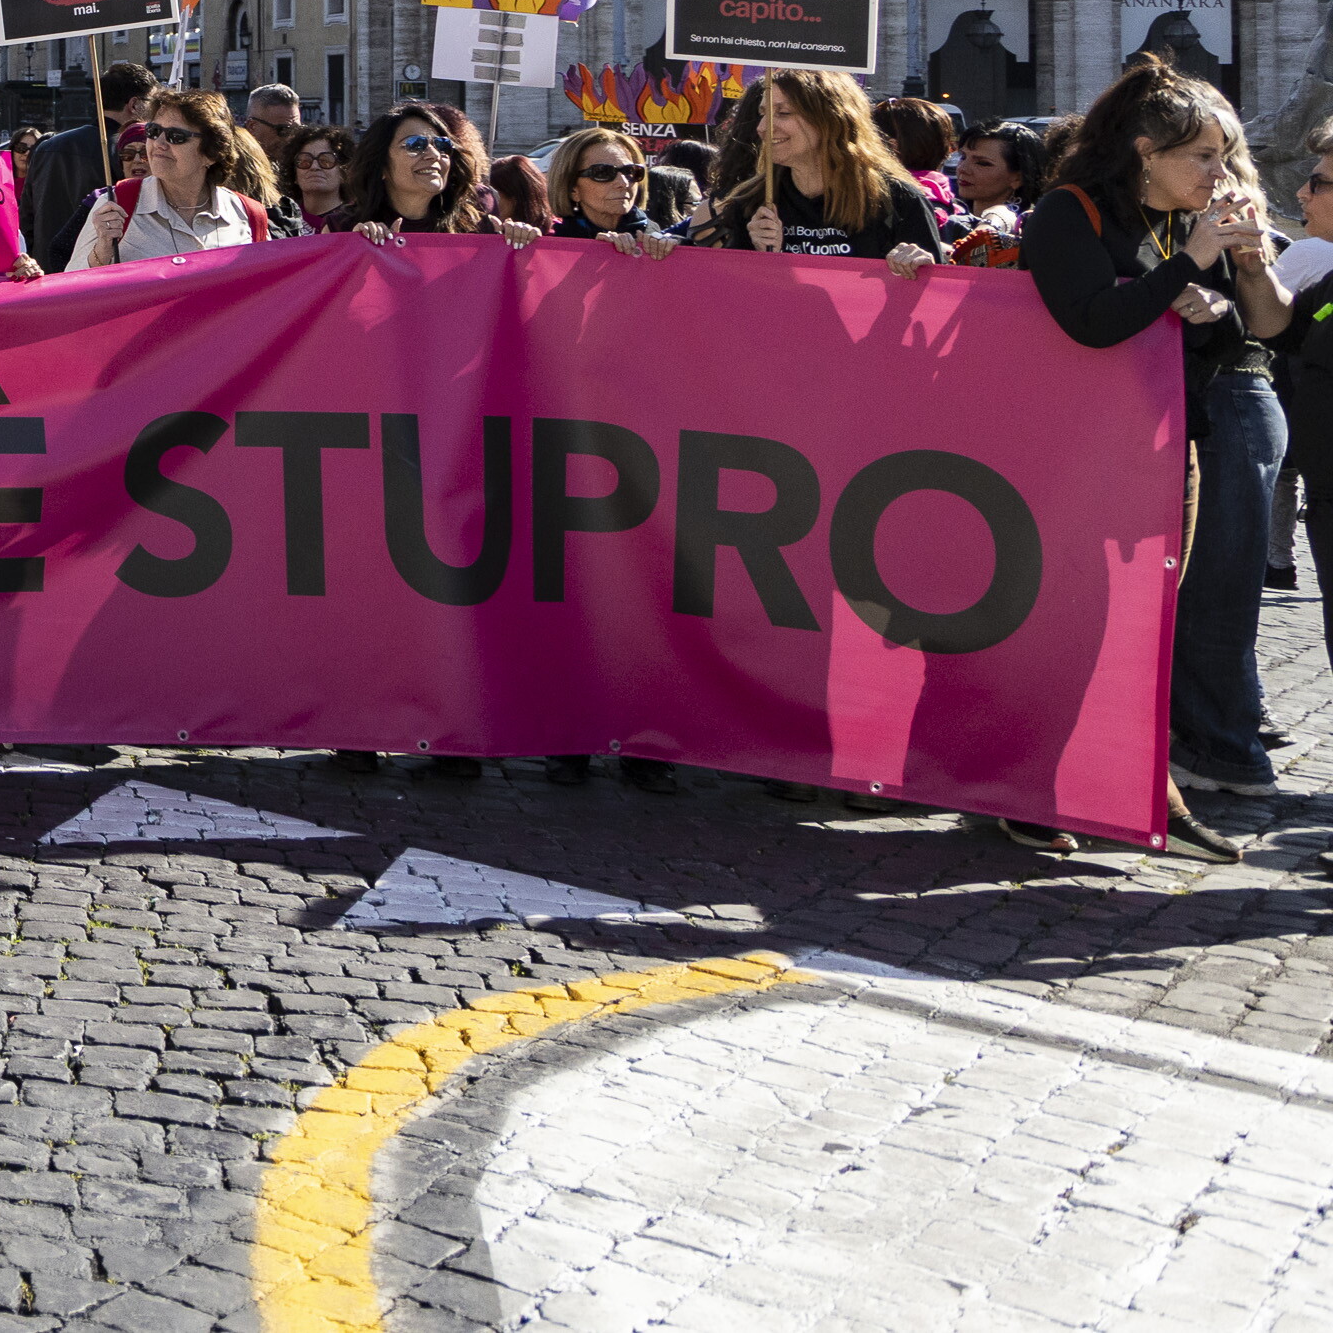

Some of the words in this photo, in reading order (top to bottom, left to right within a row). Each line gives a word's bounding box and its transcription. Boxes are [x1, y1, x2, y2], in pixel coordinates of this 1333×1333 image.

[73, 2, 100, 16] mai.
[690, 34, 701, 43] Se
[702, 36, 719, 44] non
[720, 35, 734, 45] hai
[734, 37, 767, 48] chiesto,
[768, 40, 786, 49] non
[786, 40, 801, 50] hai
[801, 42, 846, 53] consenso.
[621, 122, 677, 138] SENZA
[802, 241, 851, 255] l'uomo
[114, 410, 1044, 654] STUPRO
